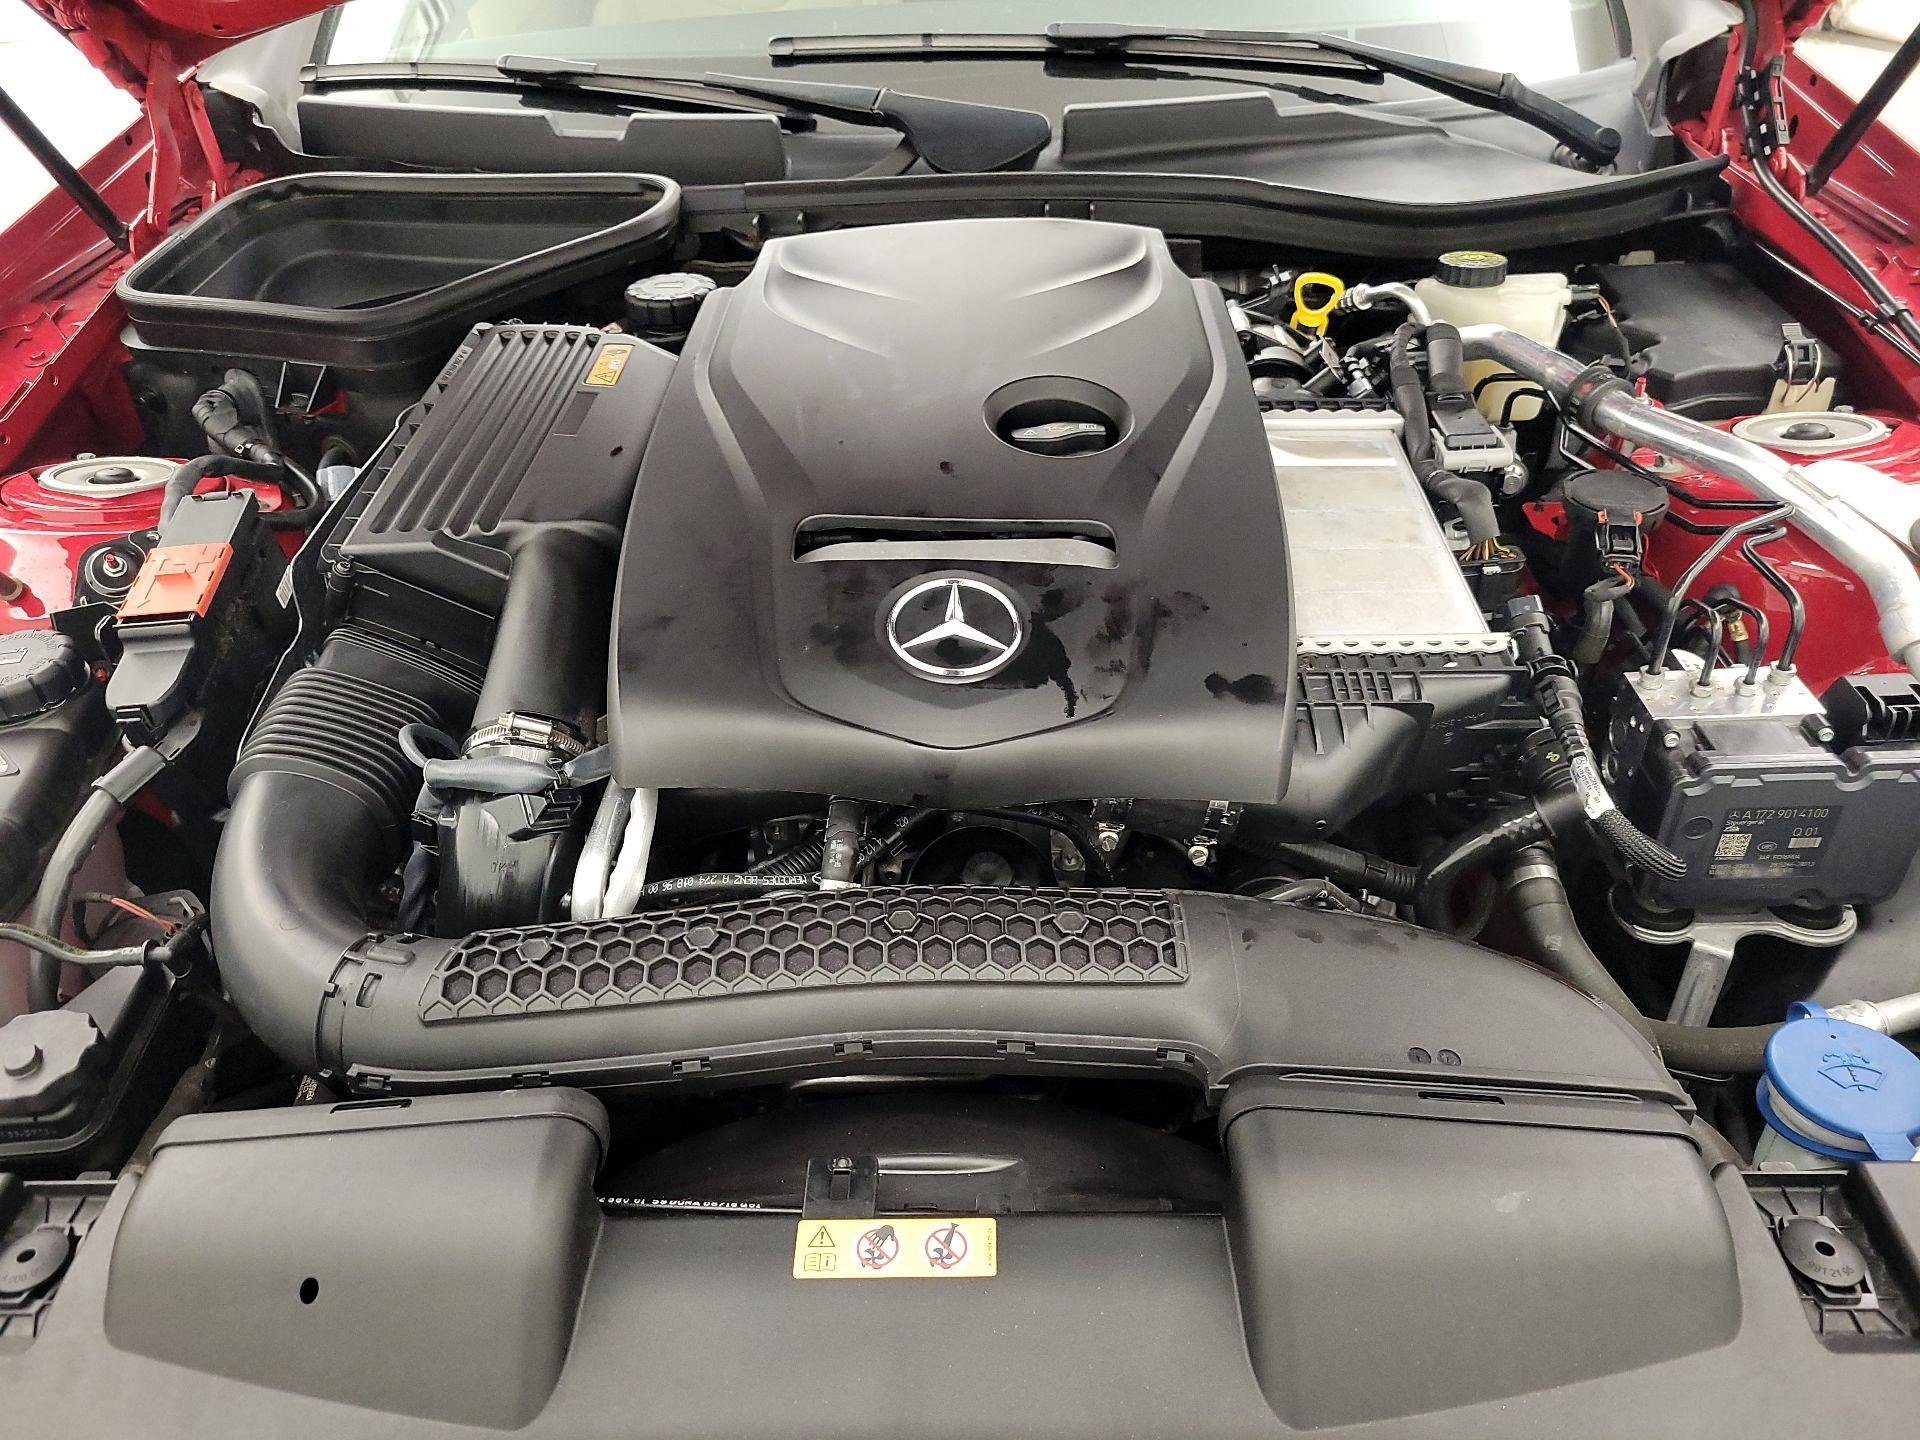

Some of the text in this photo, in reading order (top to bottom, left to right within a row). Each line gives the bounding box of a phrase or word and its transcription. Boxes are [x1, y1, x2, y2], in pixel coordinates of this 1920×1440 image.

[1742, 810, 1751, 819] A
[1756, 808, 1775, 819] 172
[1805, 827, 1819, 837] 01
[676, 876, 694, 888] 018
[698, 875, 717, 885] 274
[733, 874, 808, 887] MERCEDES-BENZ
